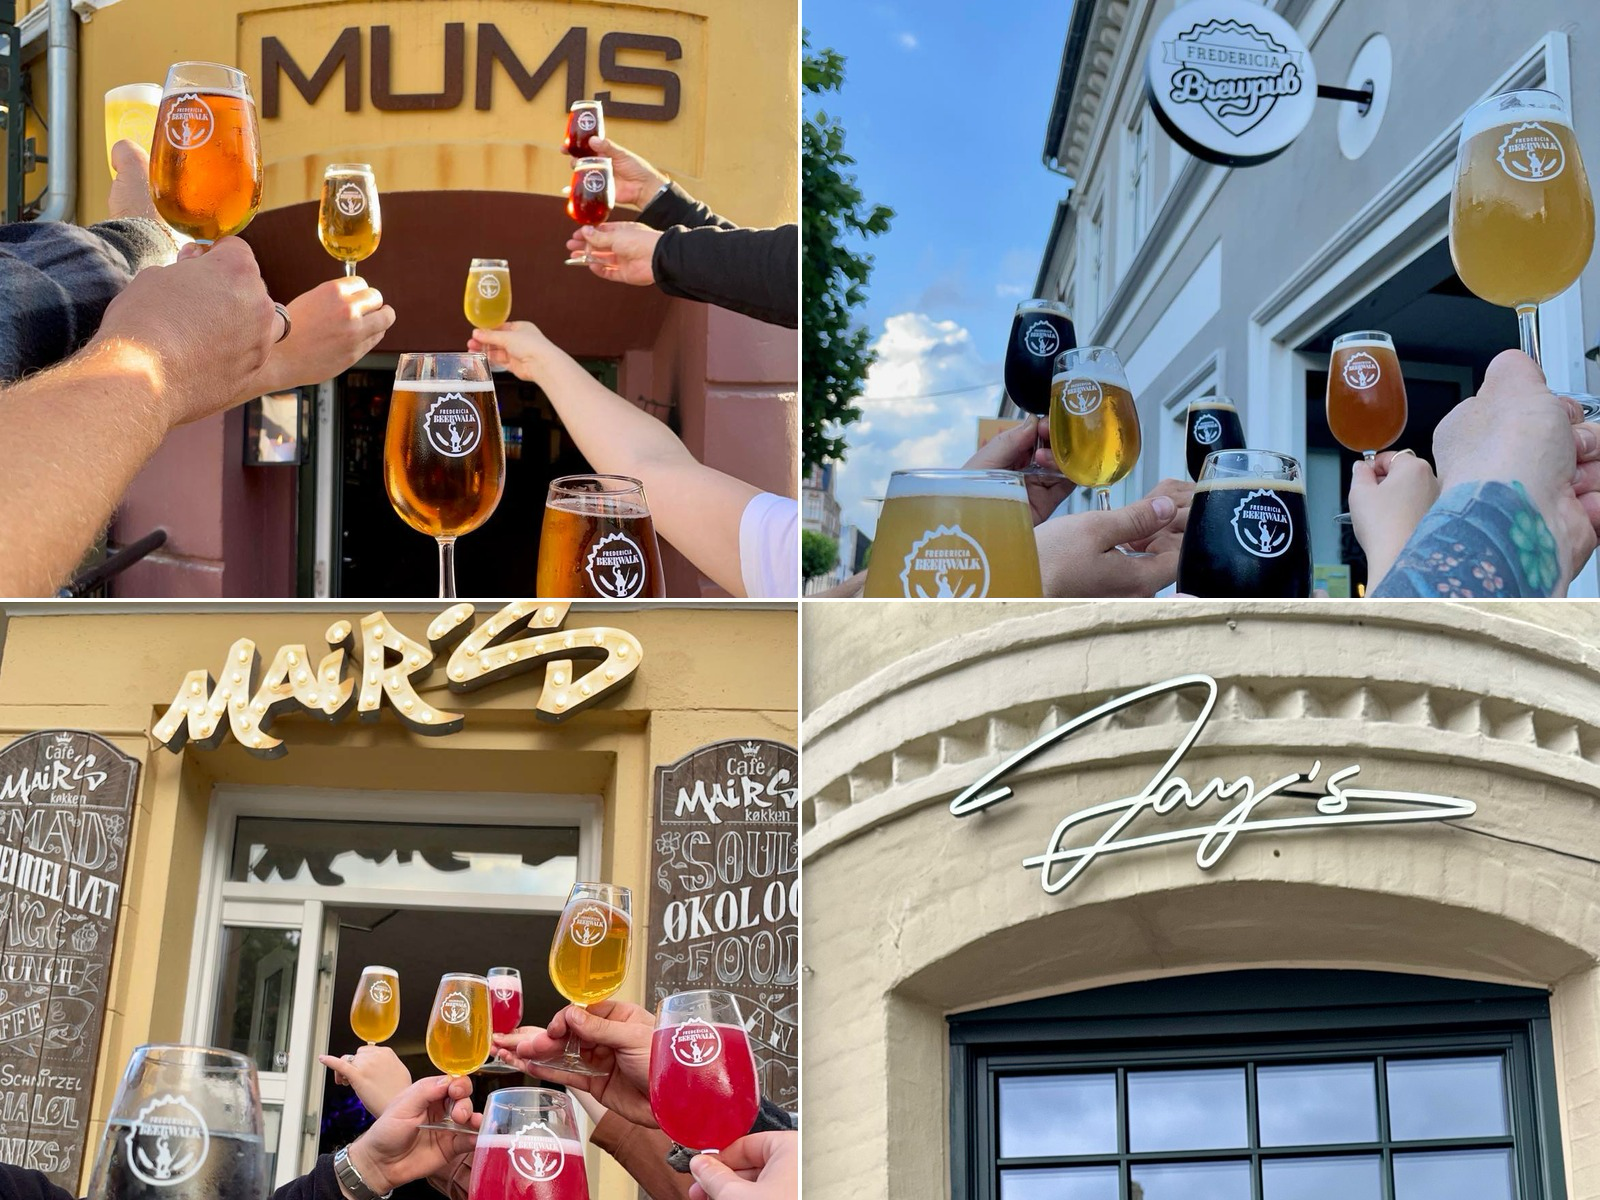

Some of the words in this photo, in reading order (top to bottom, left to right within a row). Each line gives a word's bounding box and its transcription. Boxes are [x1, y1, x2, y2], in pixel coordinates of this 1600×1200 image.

[1187, 46, 1280, 69] FREDERICIA
[262, 23, 682, 121] MUMS
[1170, 62, 1301, 117] Brewpub
[172, 112, 209, 120] BEERWALK
[1508, 141, 1559, 152] BEERWALK
[433, 414, 476, 423] BEERWALK
[1250, 504, 1281, 513] FREDERICIA
[1242, 509, 1288, 524] BEERWALK
[596, 554, 640, 566] BEERWALK
[602, 549, 632, 557] FREDERICIA
[925, 549, 971, 557] FREDERICIA
[914, 557, 981, 571] BEERWALK
[45, 745, 75, 759] Café
[726, 757, 766, 775] Café
[950, 673, 1477, 894] Jay's
[745, 808, 790, 822] køkken
[6, 809, 108, 870] MAD
[0, 845, 119, 920] EMMELAVET
[0, 892, 71, 949] AGE
[677, 1032, 716, 1042] BEERWALK
[0, 1091, 79, 1129] IALØL
[139, 1122, 202, 1139] BEERWALK
